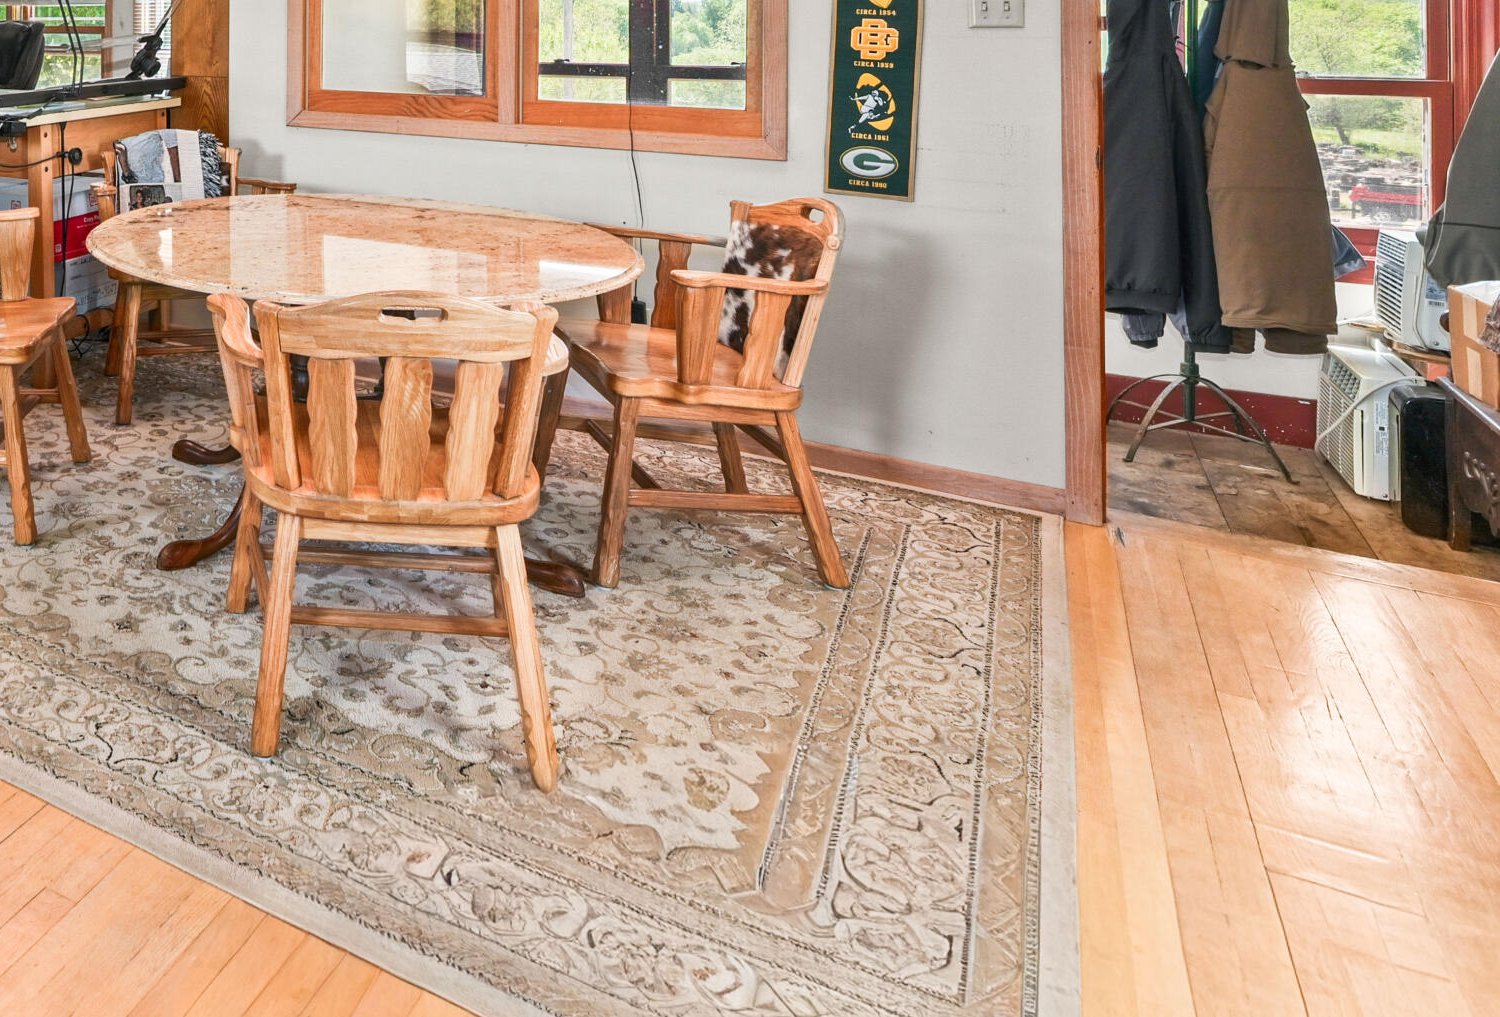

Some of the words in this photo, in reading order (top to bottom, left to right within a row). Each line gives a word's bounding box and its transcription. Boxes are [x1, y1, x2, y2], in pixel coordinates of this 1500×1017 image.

[853, 60, 875, 68] CIRCA
[851, 132, 872, 140] CIRCA
[848, 179, 870, 187] CIRCA
